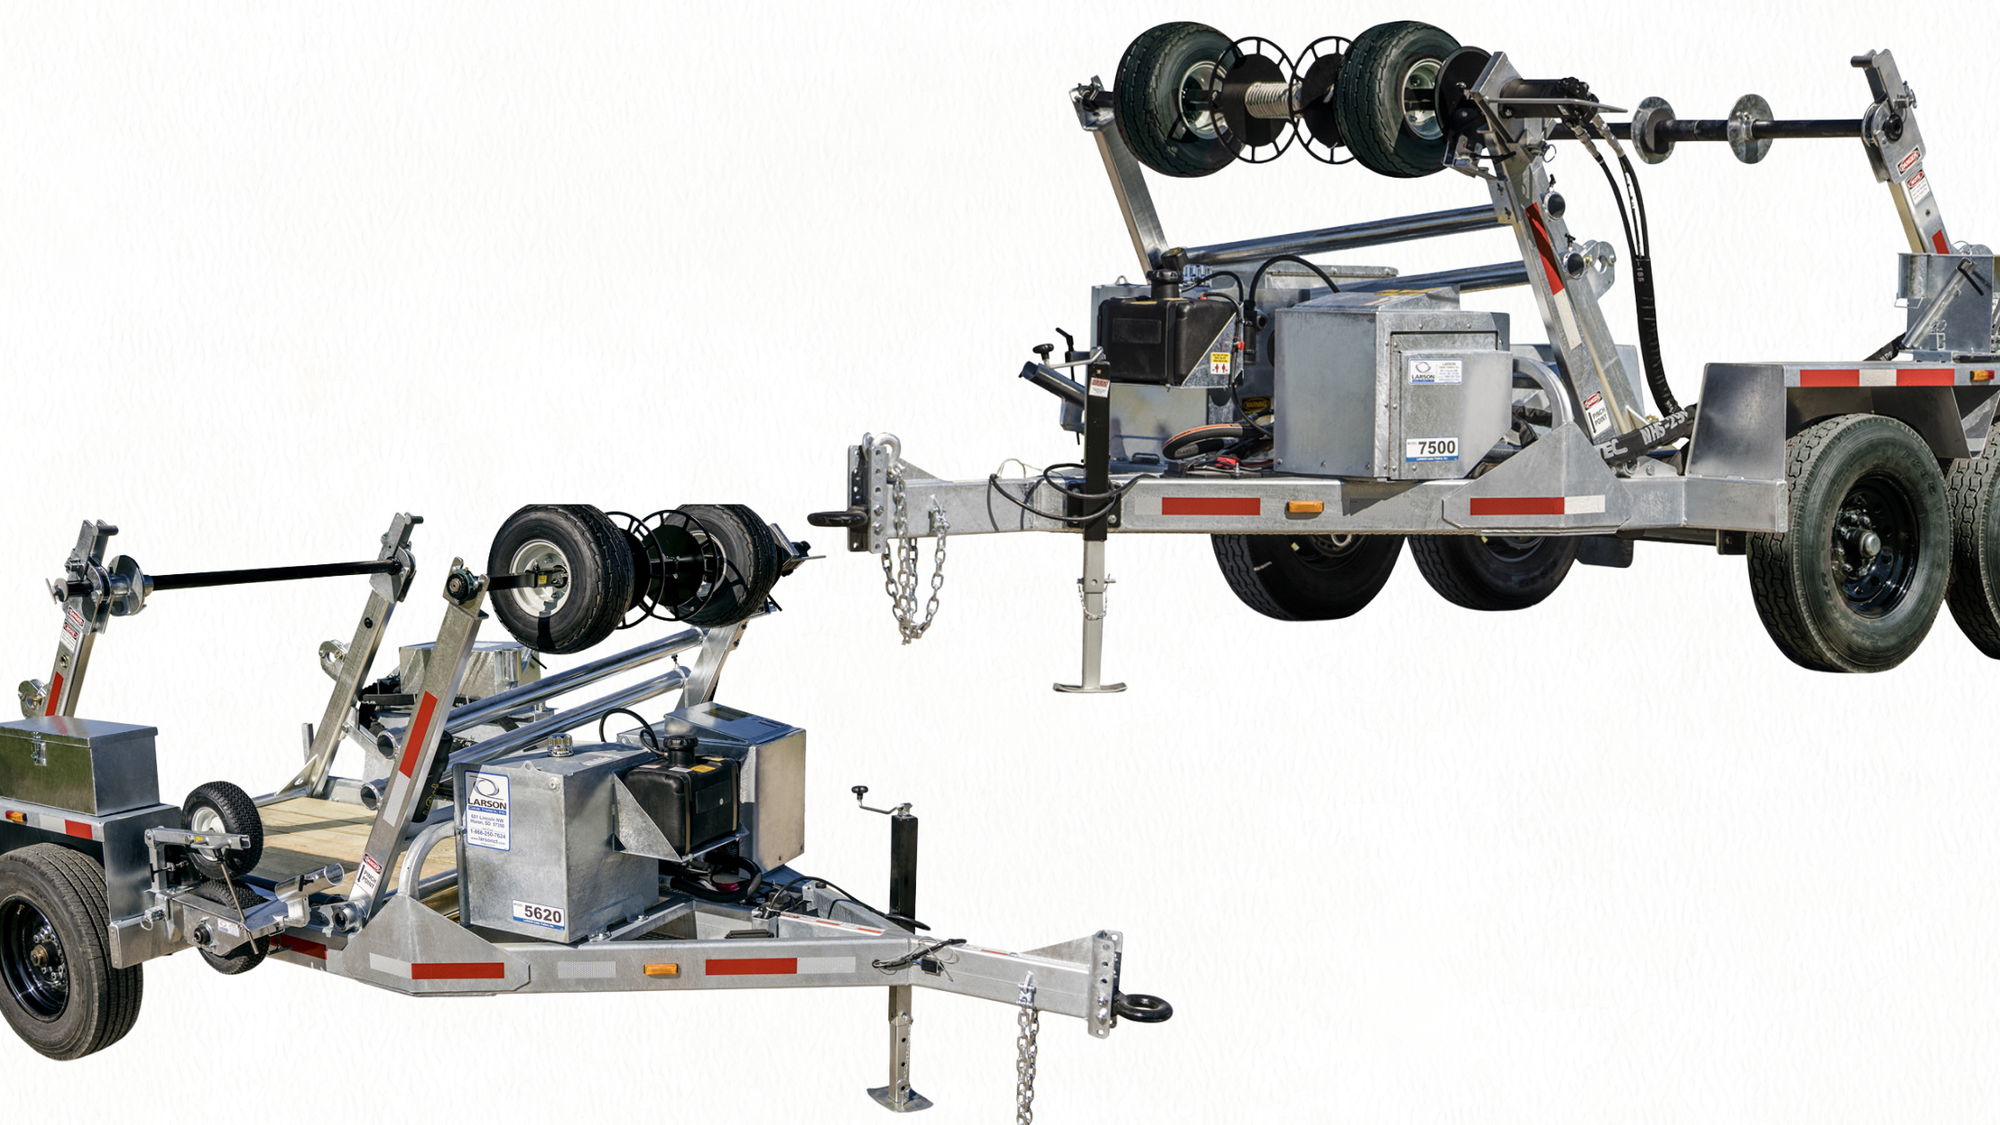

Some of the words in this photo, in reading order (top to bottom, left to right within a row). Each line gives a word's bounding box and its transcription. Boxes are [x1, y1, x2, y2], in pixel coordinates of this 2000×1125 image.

[1593, 408, 1605, 420] PINCH
[1595, 414, 1608, 426] POINT
[1418, 440, 1456, 454] 7500
[468, 798, 507, 810] LARSON
[524, 904, 562, 923] 5620
